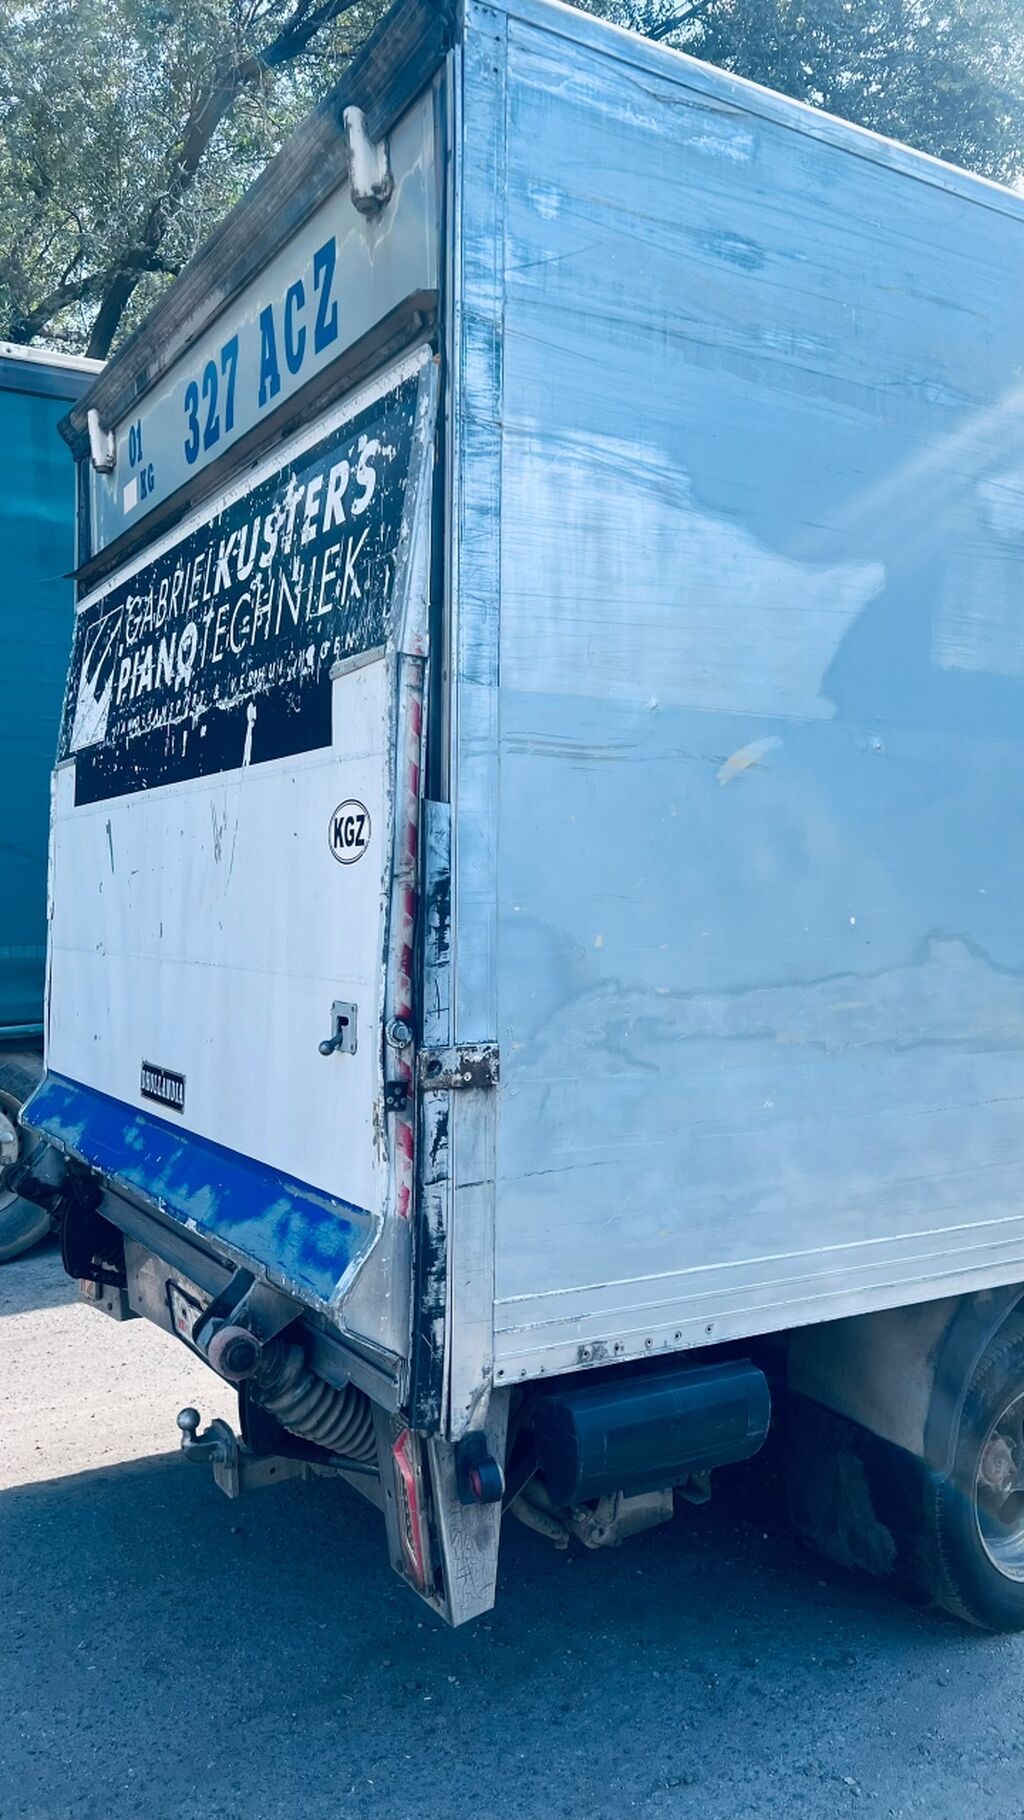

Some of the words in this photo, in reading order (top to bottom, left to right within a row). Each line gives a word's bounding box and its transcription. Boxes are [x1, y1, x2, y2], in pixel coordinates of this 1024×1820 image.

[129, 419, 143, 468] 01
[184, 334, 239, 465] 327
[258, 235, 338, 408] ACZ
[140, 463, 155, 500] KG
[334, 814, 365, 848] KGZ
